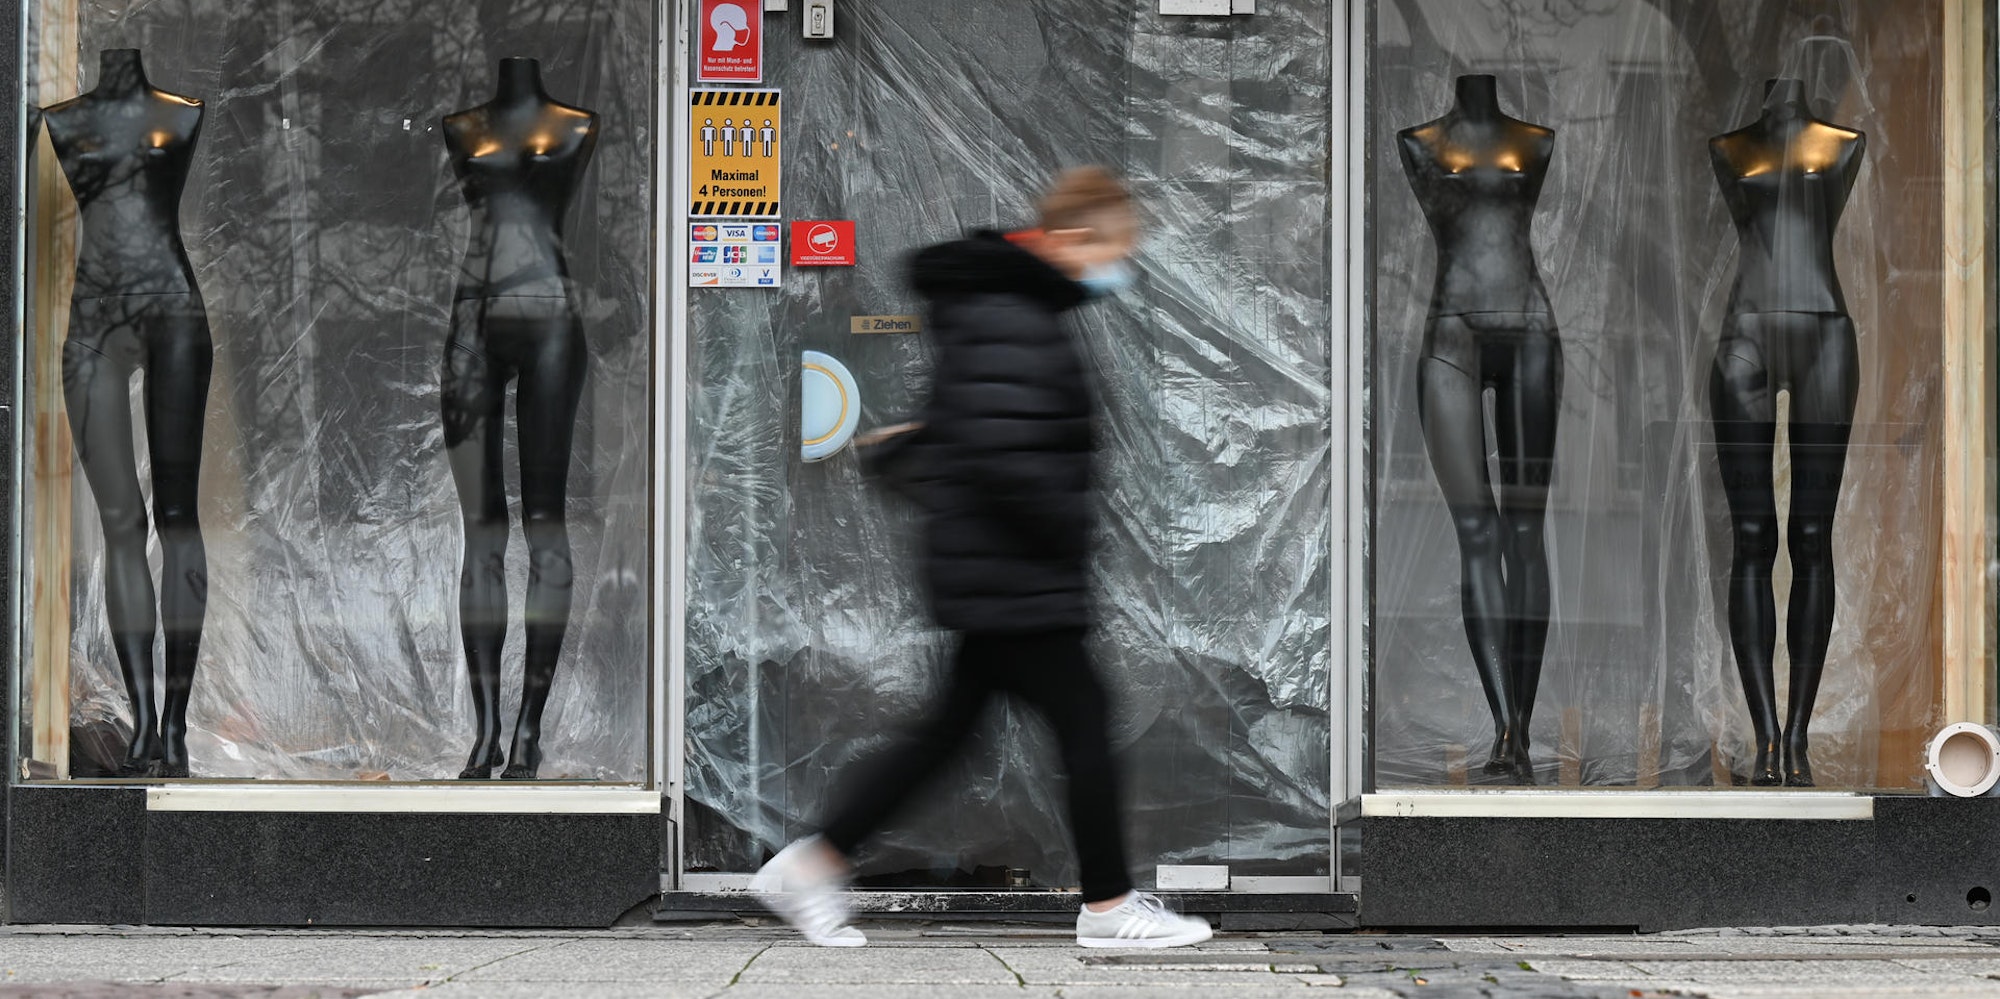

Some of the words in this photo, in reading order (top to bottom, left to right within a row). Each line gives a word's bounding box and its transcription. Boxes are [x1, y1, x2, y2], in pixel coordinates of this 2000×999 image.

[711, 169, 759, 181] Maximal
[699, 184, 708, 197] 4
[712, 185, 766, 197] Personen!
[726, 229, 746, 237] VISA
[873, 319, 911, 330] Ziehen
